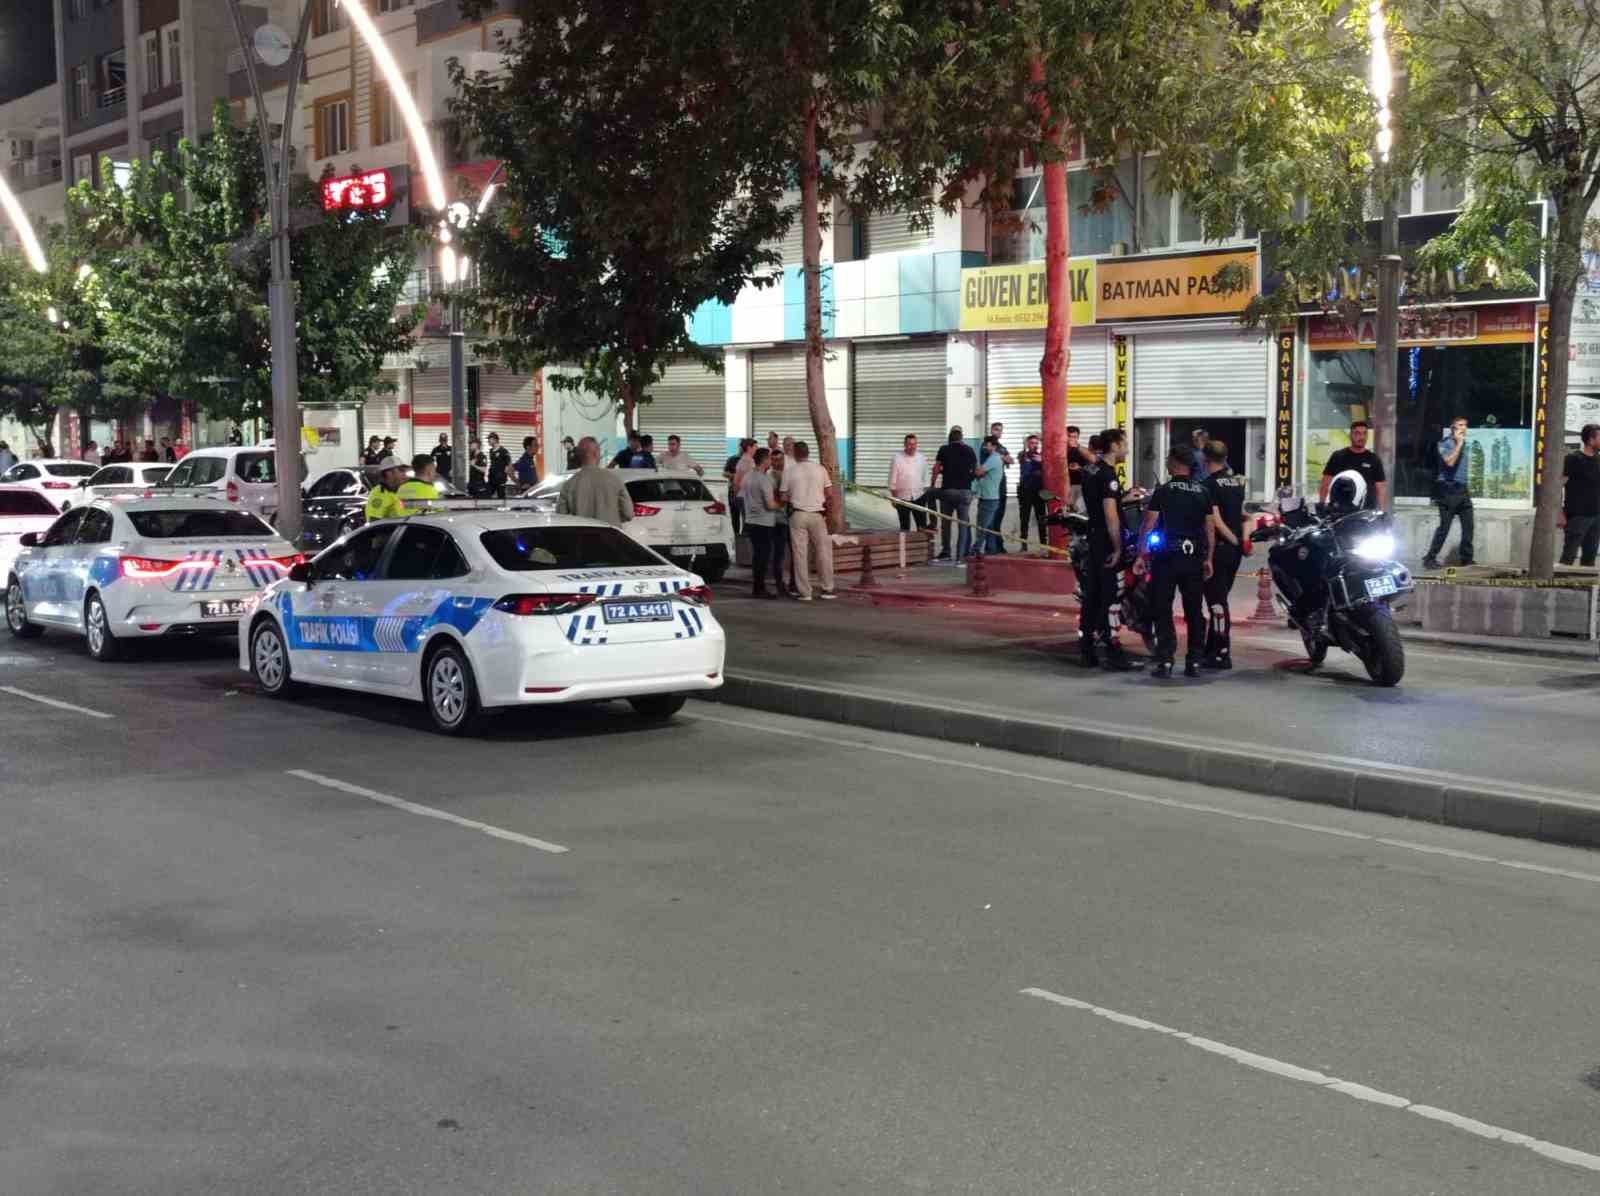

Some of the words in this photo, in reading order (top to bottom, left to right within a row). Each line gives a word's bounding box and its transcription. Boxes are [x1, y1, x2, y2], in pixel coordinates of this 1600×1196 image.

[965, 269, 1021, 308] GÜVEN
[1102, 277, 1181, 301] BATMAN
[609, 606, 625, 618] 72
[628, 606, 639, 617] A
[641, 603, 669, 615] 5411
